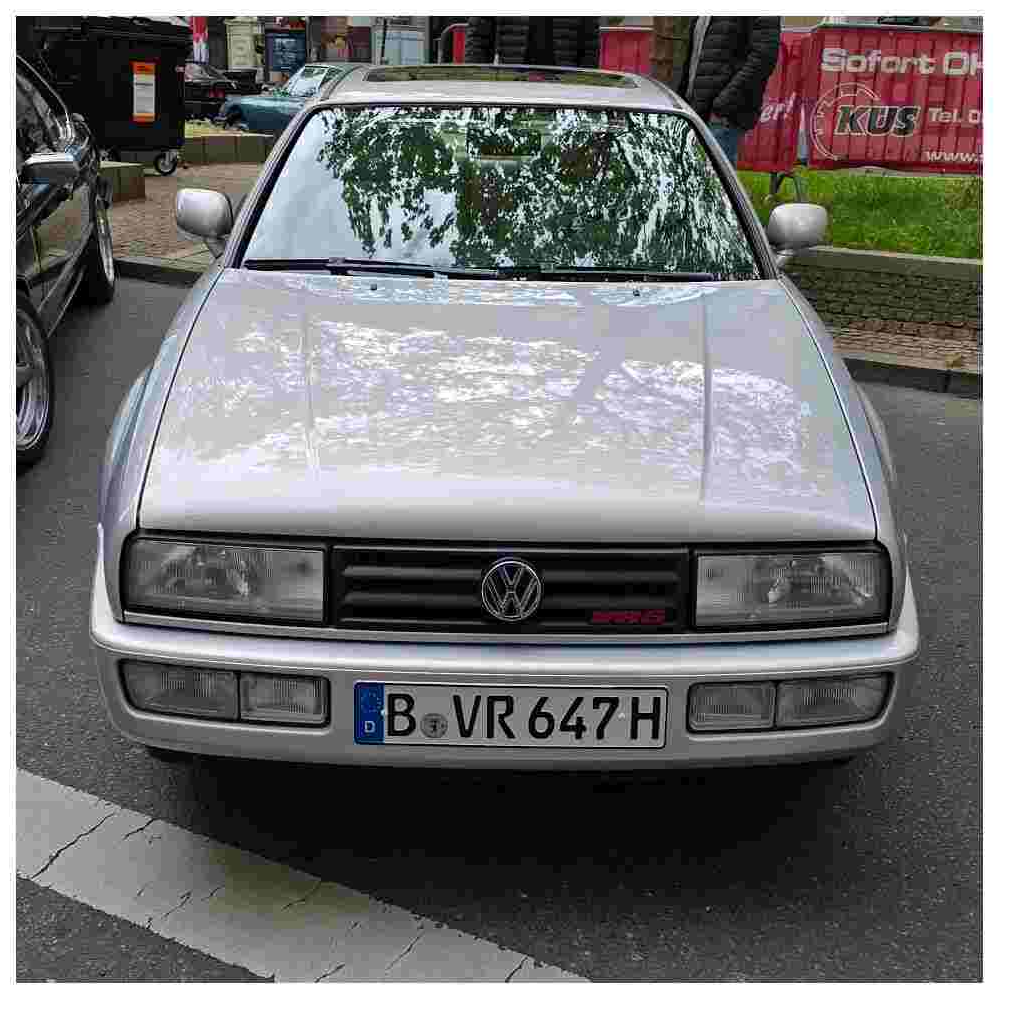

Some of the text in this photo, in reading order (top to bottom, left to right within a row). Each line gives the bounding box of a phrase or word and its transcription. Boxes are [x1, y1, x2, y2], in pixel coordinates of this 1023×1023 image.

[821, 47, 937, 75] Sofort
[364, 720, 376, 733] D
[386, 693, 417, 737] B
[452, 694, 516, 739] VR
